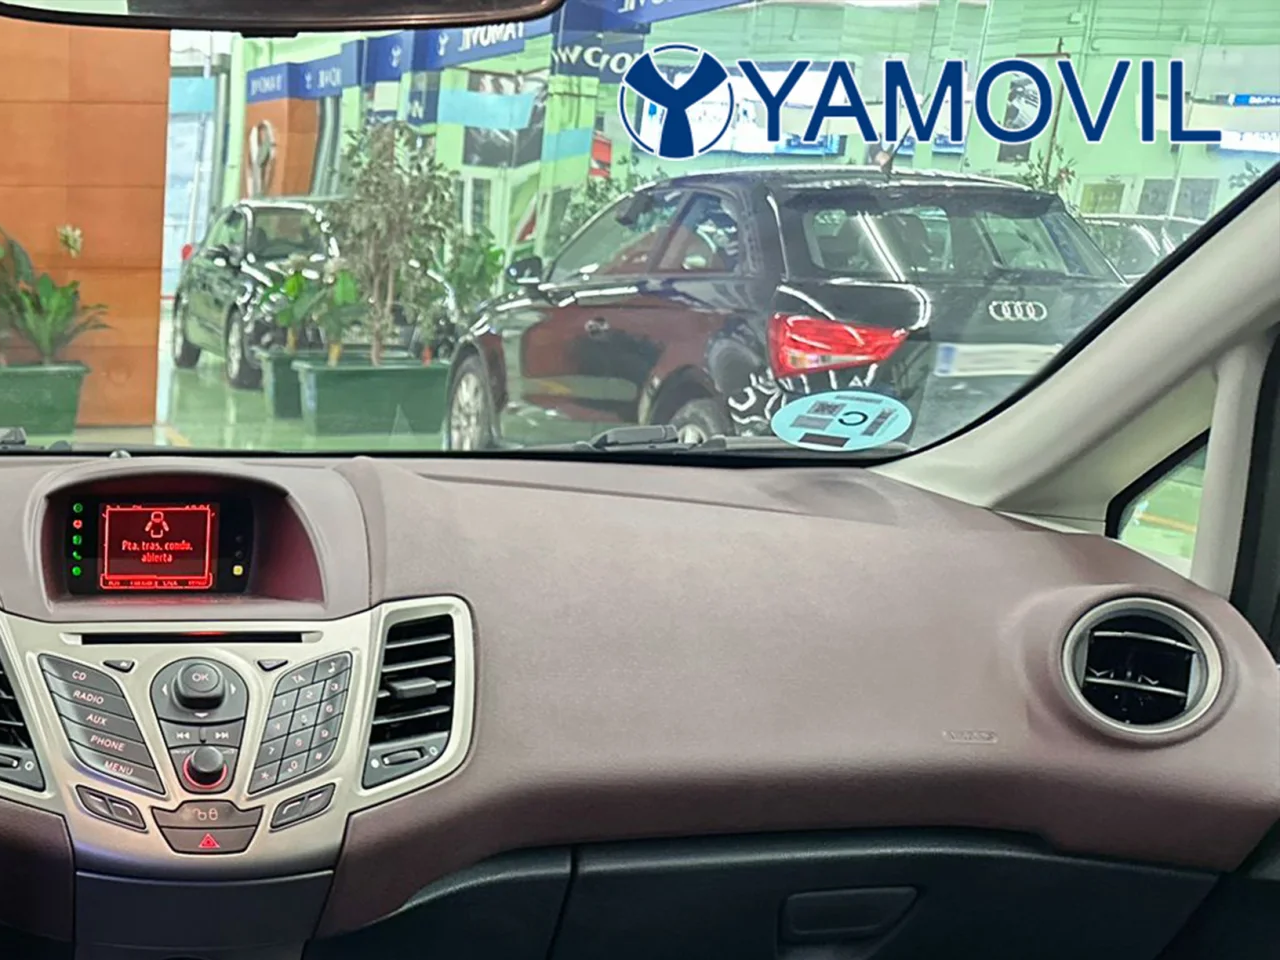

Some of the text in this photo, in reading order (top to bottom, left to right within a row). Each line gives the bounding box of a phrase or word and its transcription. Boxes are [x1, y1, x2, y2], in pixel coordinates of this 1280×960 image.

[72, 670, 87, 681] CD
[192, 672, 209, 682] OK
[73, 690, 104, 705] RADIO
[87, 713, 107, 726] AUX
[90, 735, 125, 752] PHONE
[104, 760, 134, 776] MENU
